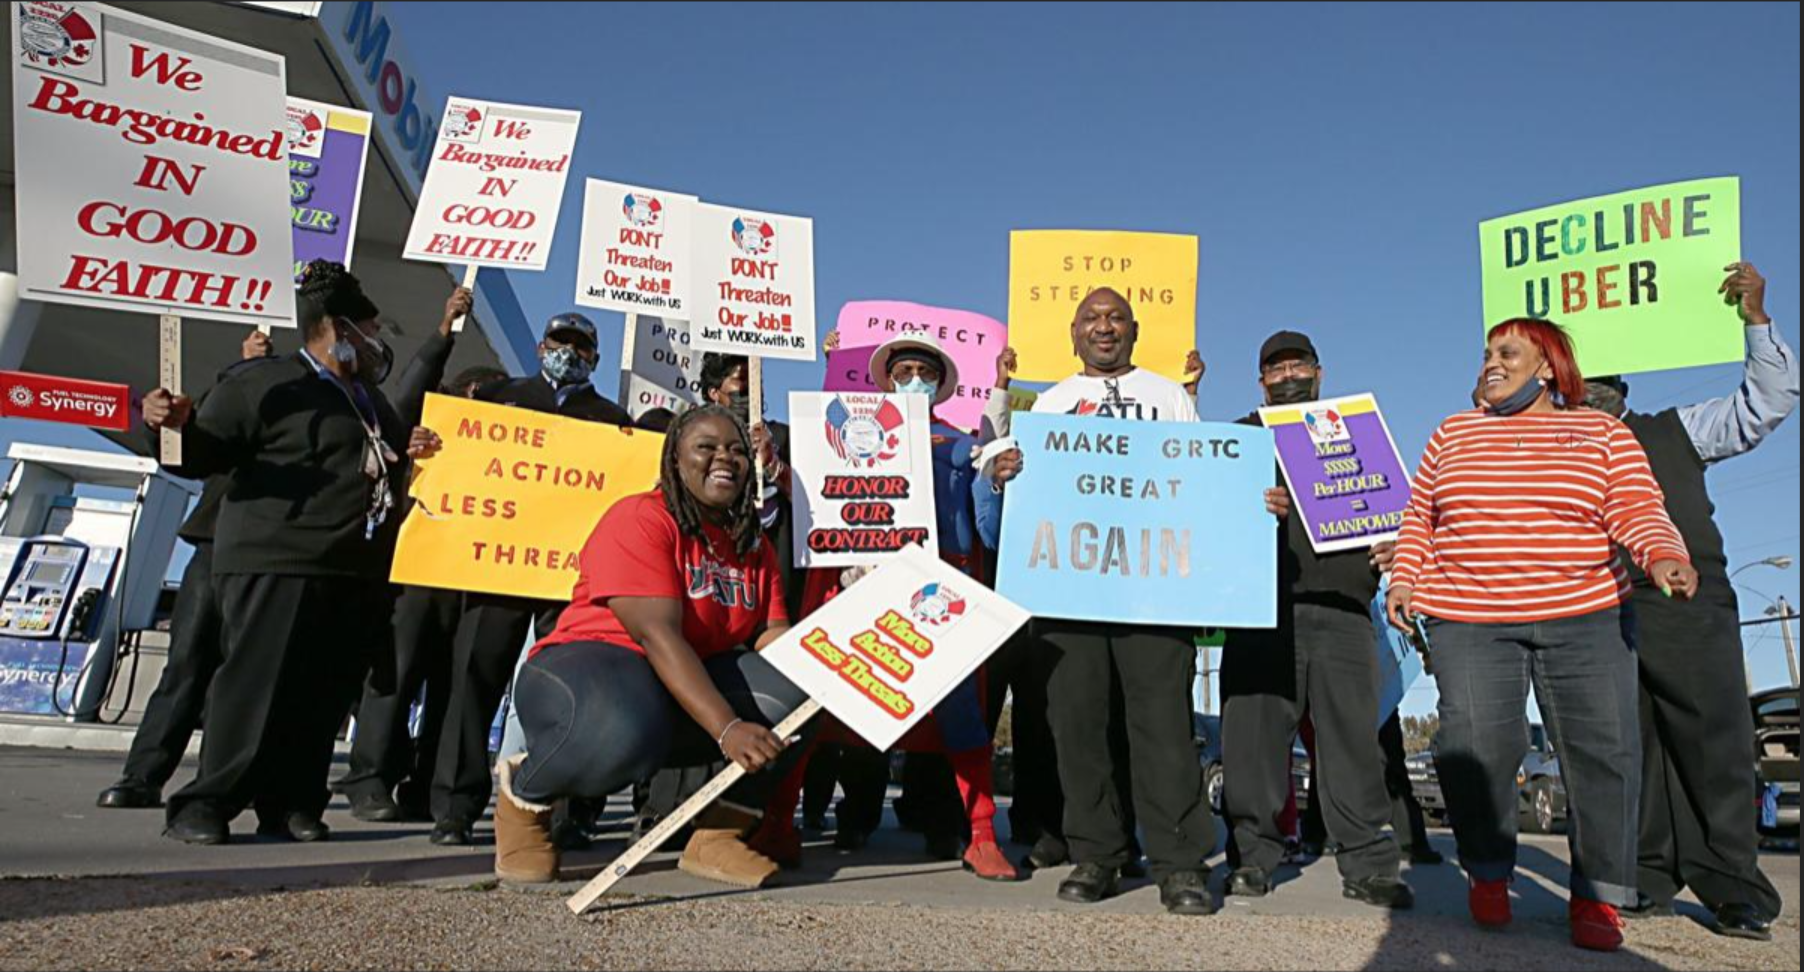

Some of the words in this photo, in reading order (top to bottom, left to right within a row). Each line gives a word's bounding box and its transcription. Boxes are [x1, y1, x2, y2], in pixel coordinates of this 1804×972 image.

[128, 43, 204, 91] We
[28, 75, 284, 162] Bargained
[493, 119, 531, 140] We
[438, 143, 569, 172] Bargained
[133, 155, 206, 196] IN
[478, 176, 519, 198] IN
[77, 201, 258, 257] GOOD
[442, 203, 536, 230] GOOD
[620, 228, 664, 249] DON'T
[1504, 194, 1711, 268] DECLINE
[606, 248, 673, 272] Threaten
[731, 257, 778, 280] DON'T
[1062, 256, 1132, 273] STOP
[604, 269, 631, 288] Our
[1524, 260, 1658, 319] UBER
[586, 285, 606, 298] Just
[611, 289, 643, 304] WORK
[643, 294, 667, 307] with
[669, 298, 681, 309] US
[718, 281, 791, 307] Threaten
[718, 306, 749, 327] Our
[701, 326, 722, 340] Just
[727, 329, 763, 344] WORK
[763, 334, 788, 347] with
[791, 336, 805, 348] US
[867, 317, 986, 346] PROTECT
[652, 349, 690, 370] OUR
[40, 391, 117, 418] Synergy
[640, 390, 677, 410] OUT
[457, 418, 546, 448] MORE
[1044, 431, 1130, 456] MAKE
[1162, 438, 1240, 459] GRTC
[1315, 442, 1354, 458] More
[485, 458, 605, 491] ACTION
[822, 475, 908, 498] HONOR
[1076, 474, 1182, 499] GREAT
[1314, 482, 1336, 498] Per
[1337, 474, 1388, 495] HOUR
[441, 493, 517, 518] LESS
[841, 503, 894, 525] OUR
[1319, 511, 1405, 538] MANPOWE
[807, 528, 928, 552] CONTRACT
[1028, 521, 1192, 578] AGAIN
[472, 542, 580, 571] THREA
[875, 609, 933, 659] More
[850, 630, 914, 683] Action
[0, 666, 73, 685] ynergy
[800, 627, 847, 671] Less
[838, 654, 914, 720] Threats
